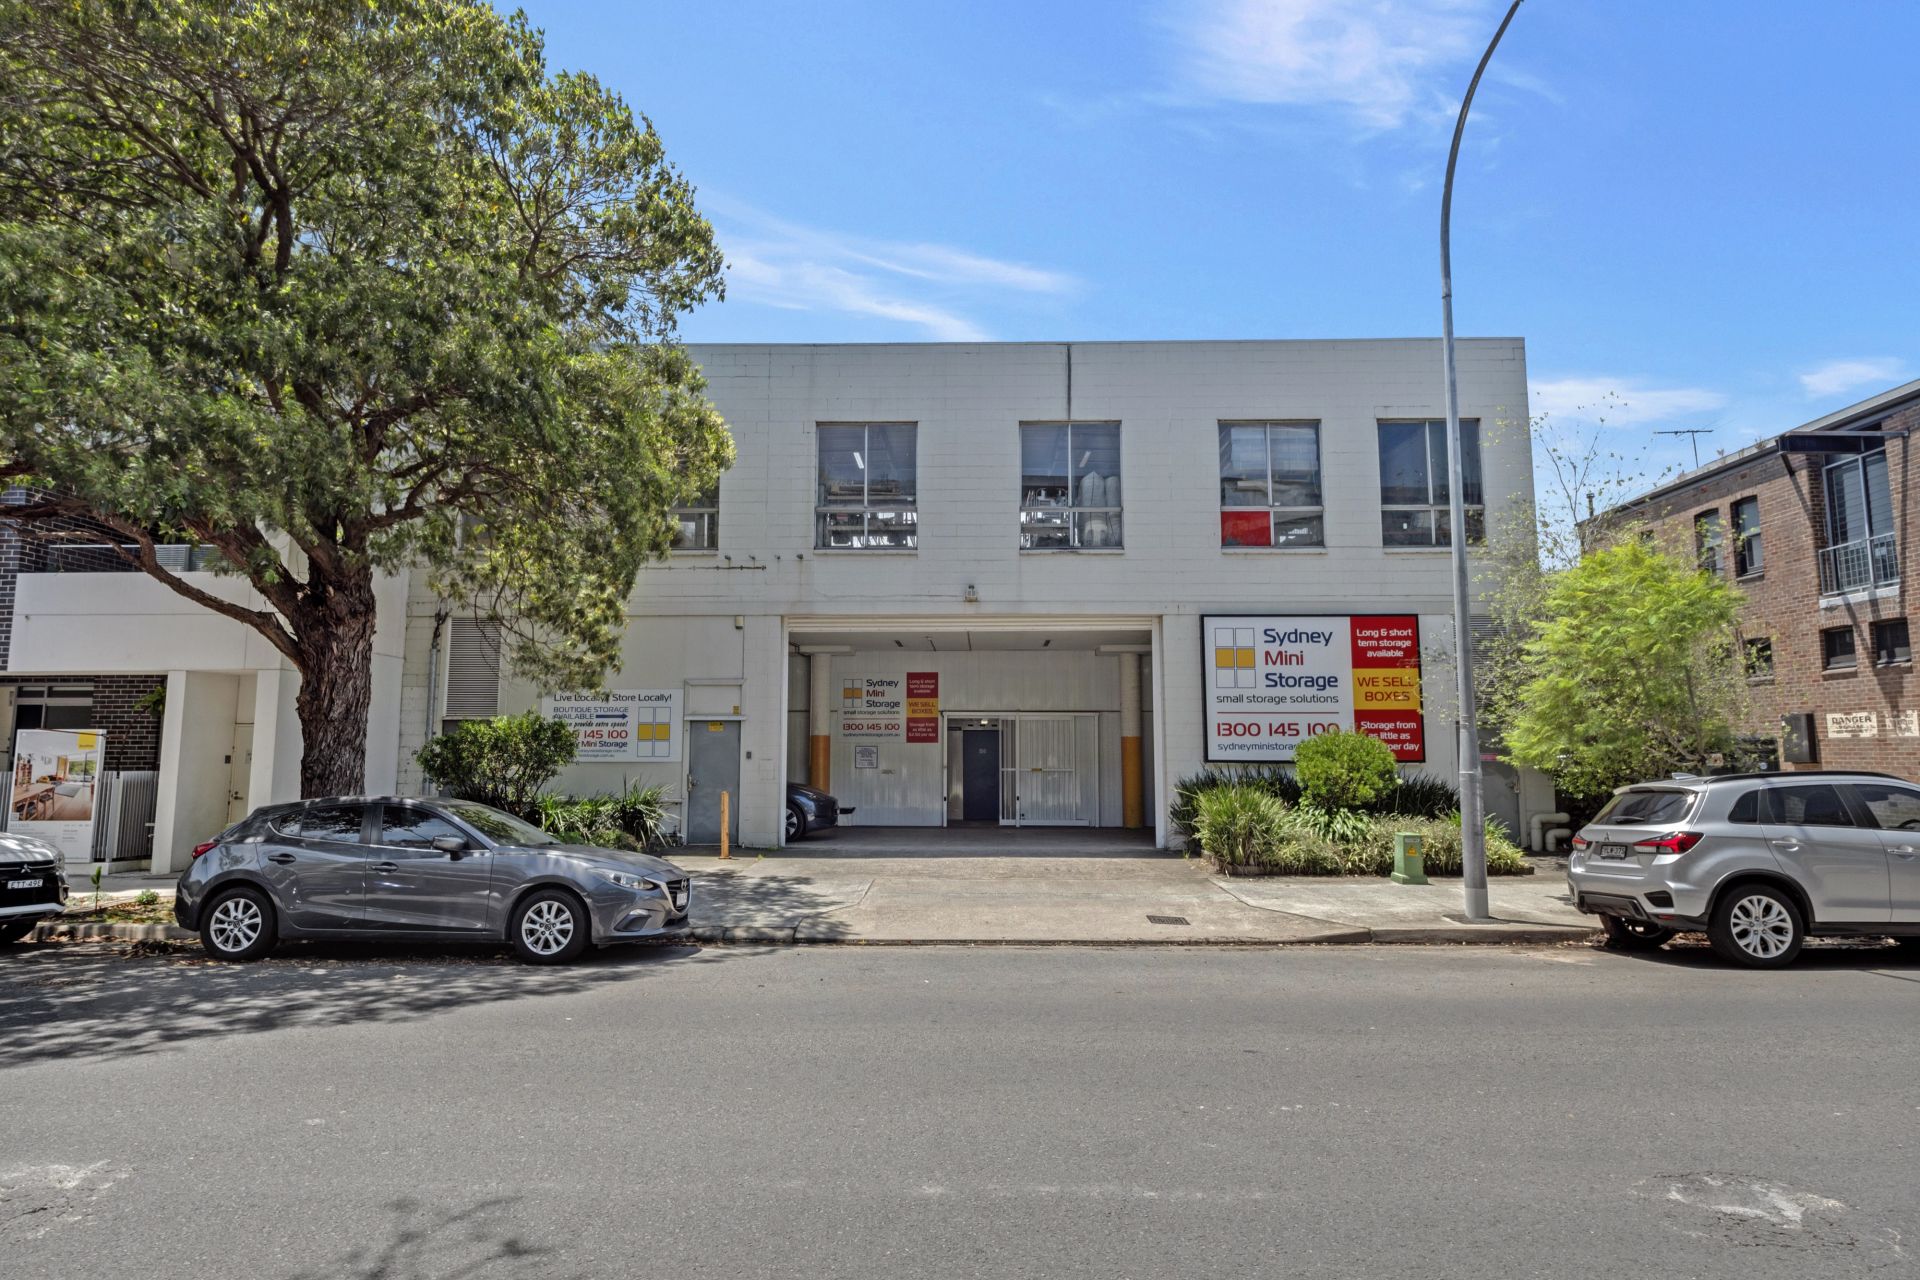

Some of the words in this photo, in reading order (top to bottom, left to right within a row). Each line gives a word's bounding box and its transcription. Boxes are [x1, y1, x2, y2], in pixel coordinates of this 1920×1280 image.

[1264, 628, 1333, 646] Sydney
[1356, 628, 1378, 638] Long
[1380, 628, 1388, 636] &
[1388, 628, 1412, 637] short
[1379, 639, 1412, 648] storage
[1264, 650, 1304, 666] Mini
[1366, 649, 1404, 658] available
[866, 679, 899, 688] Sydney
[1265, 672, 1338, 690] Storage
[1358, 677, 1380, 686] WE
[1382, 677, 1414, 687] SELL
[638, 694, 672, 703] Locally!
[1216, 694, 1244, 703] small
[1246, 694, 1287, 705] storage
[1290, 694, 1339, 703] solutions
[1364, 692, 1410, 701] BOXES
[866, 700, 900, 708] Storage
[1216, 722, 1260, 736] 1300
[1269, 722, 1300, 736] 145
[1360, 721, 1394, 730] Storage
[584, 730, 604, 739] 145
[608, 730, 628, 739] 100
[1380, 732, 1398, 740] little
[1403, 742, 1420, 751] day
